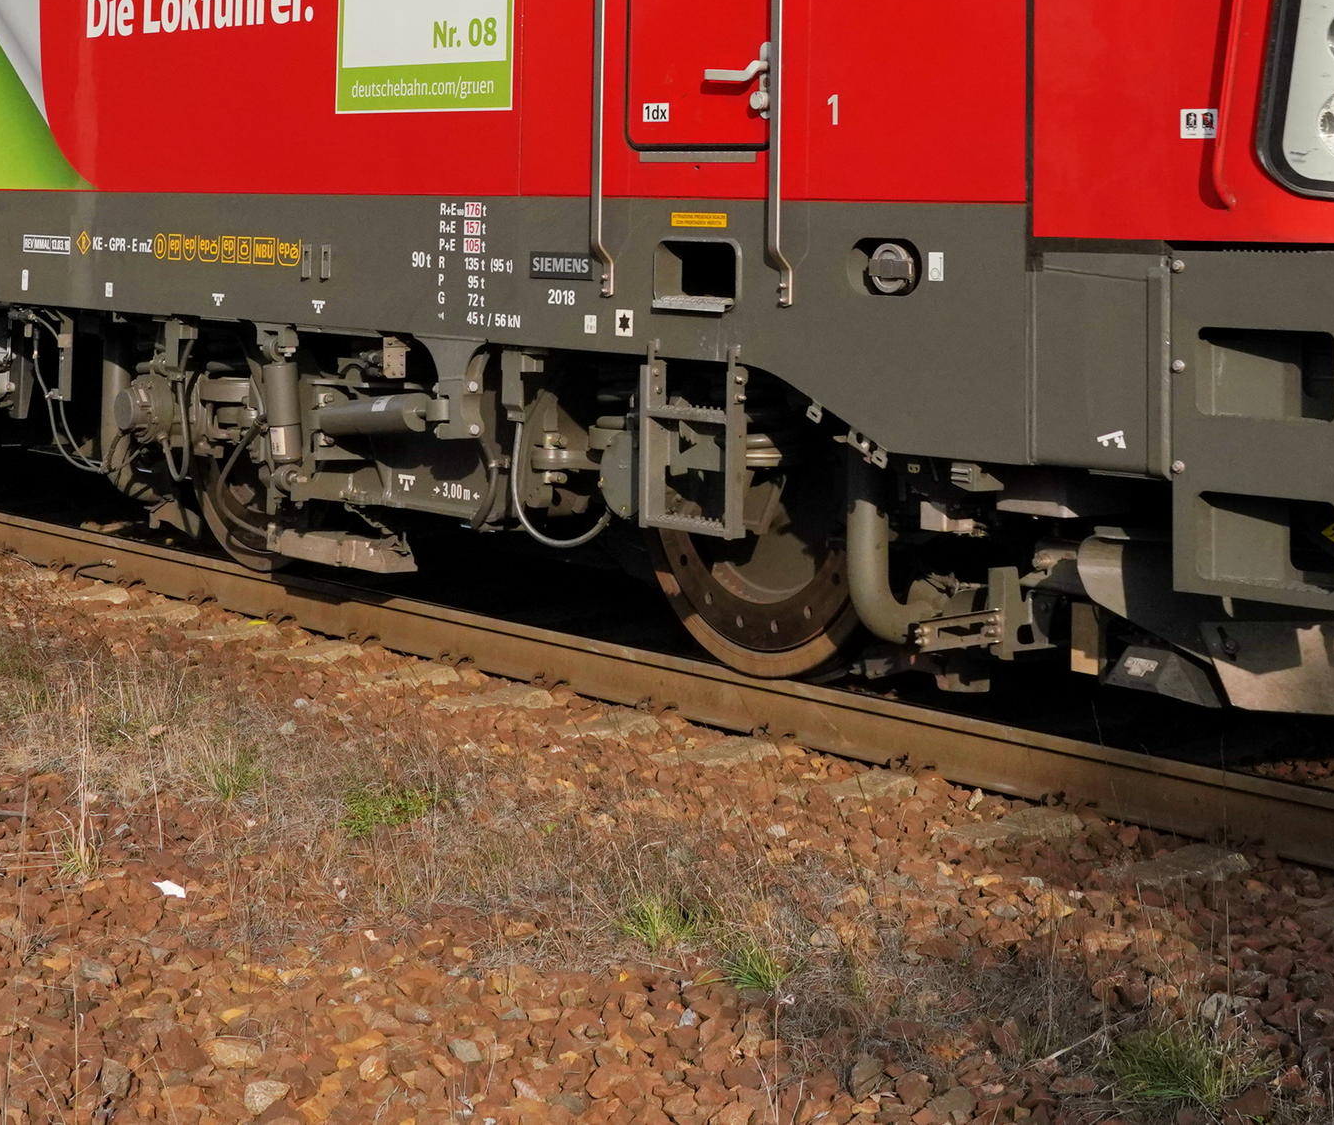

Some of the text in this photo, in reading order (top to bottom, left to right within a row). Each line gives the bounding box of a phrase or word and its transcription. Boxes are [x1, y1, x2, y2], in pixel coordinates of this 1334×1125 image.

[433, 17, 497, 49] Nr. 08
[351, 76, 495, 99] deutschebahn.com/gruen
[644, 105, 667, 121] 1dx
[827, 94, 839, 125] 1
[466, 204, 481, 216] 176
[482, 205, 487, 216] t
[439, 220, 486, 234] R+E 157 t
[92, 237, 103, 250] KE
[109, 237, 125, 251] GPR
[132, 239, 137, 252] E
[139, 239, 152, 252] mZ
[439, 238, 486, 253] P+E 105 t
[411, 251, 431, 268] 90 t
[438, 256, 513, 273] R 135 t (95 t)
[532, 257, 589, 273] SIEMENS
[438, 274, 485, 289] P 95 t
[438, 291, 485, 307] G 72 t
[547, 289, 575, 305] 2018
[467, 311, 521, 328] 45 t / 56 kN
[442, 482, 470, 501] 3,00 m
